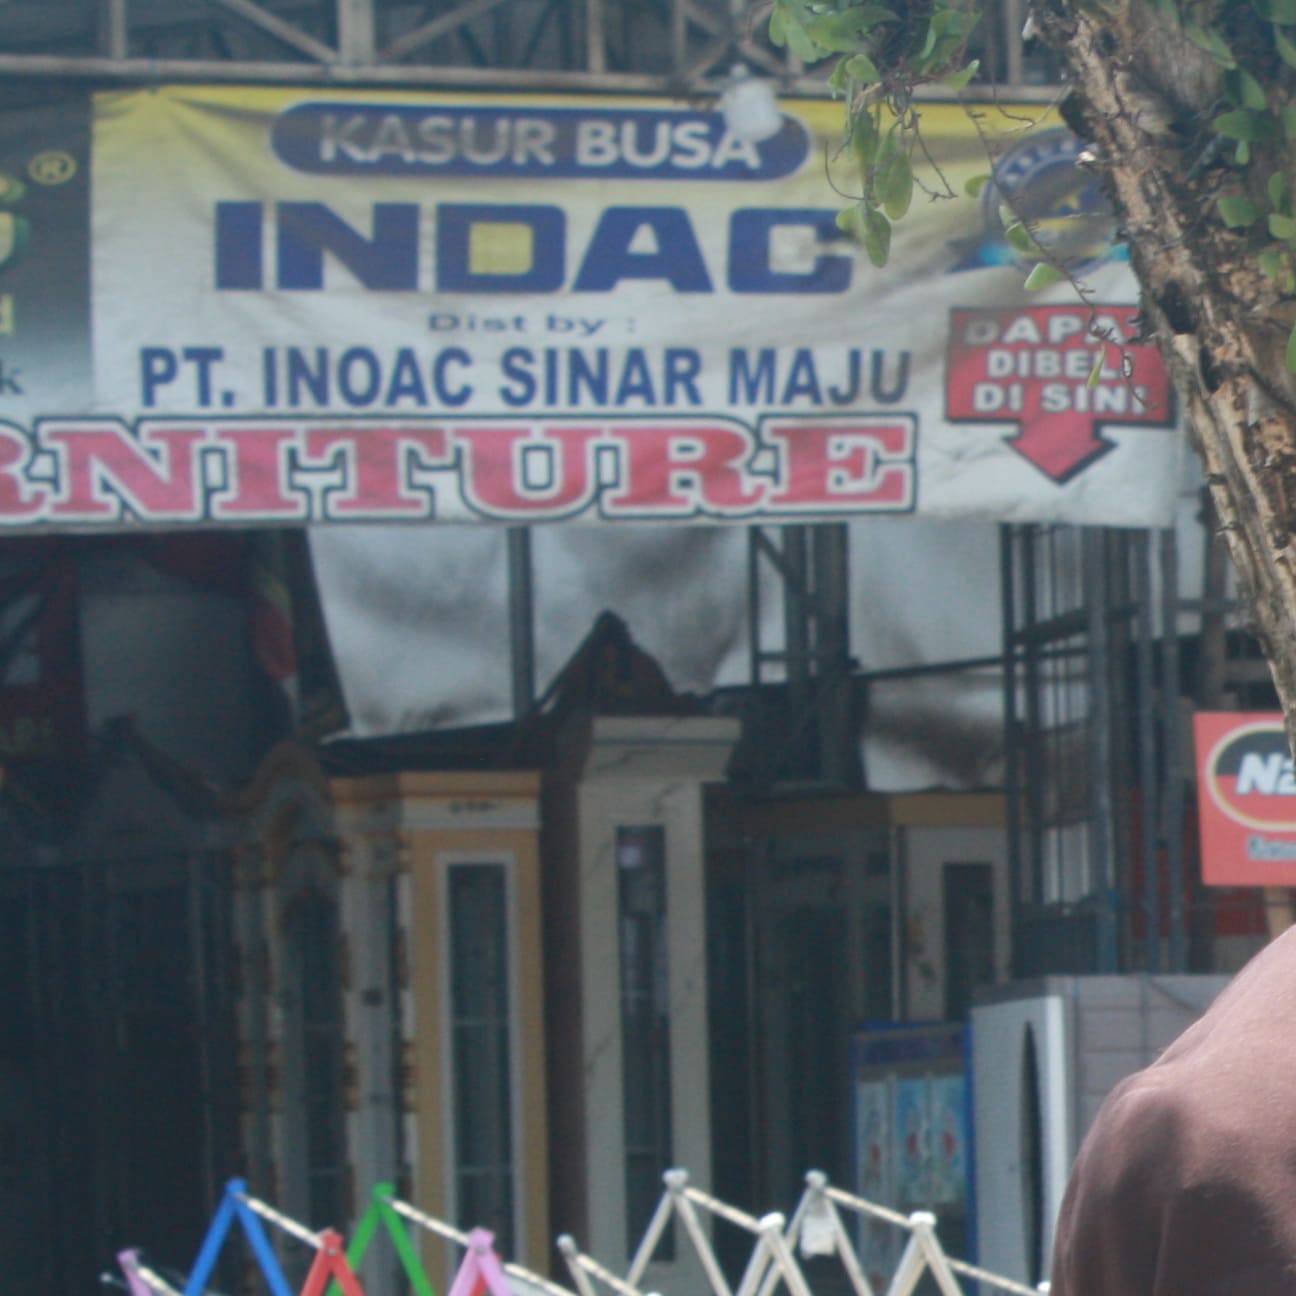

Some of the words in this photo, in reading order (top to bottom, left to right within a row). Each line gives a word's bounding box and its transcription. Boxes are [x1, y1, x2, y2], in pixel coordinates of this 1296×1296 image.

[319, 113, 557, 166] KASUR
[575, 119, 762, 170] BUSA
[214, 199, 855, 295] INDAC
[428, 312, 527, 333] Dist
[962, 314, 1140, 346] DAPA
[139, 346, 237, 408] PT.
[263, 346, 474, 408] INOAC
[499, 346, 701, 408] SINAR
[728, 346, 912, 406] MAJU
[986, 349, 1132, 380] DIBEL
[972, 383, 1024, 413] DI
[1040, 383, 1148, 416] SINI
